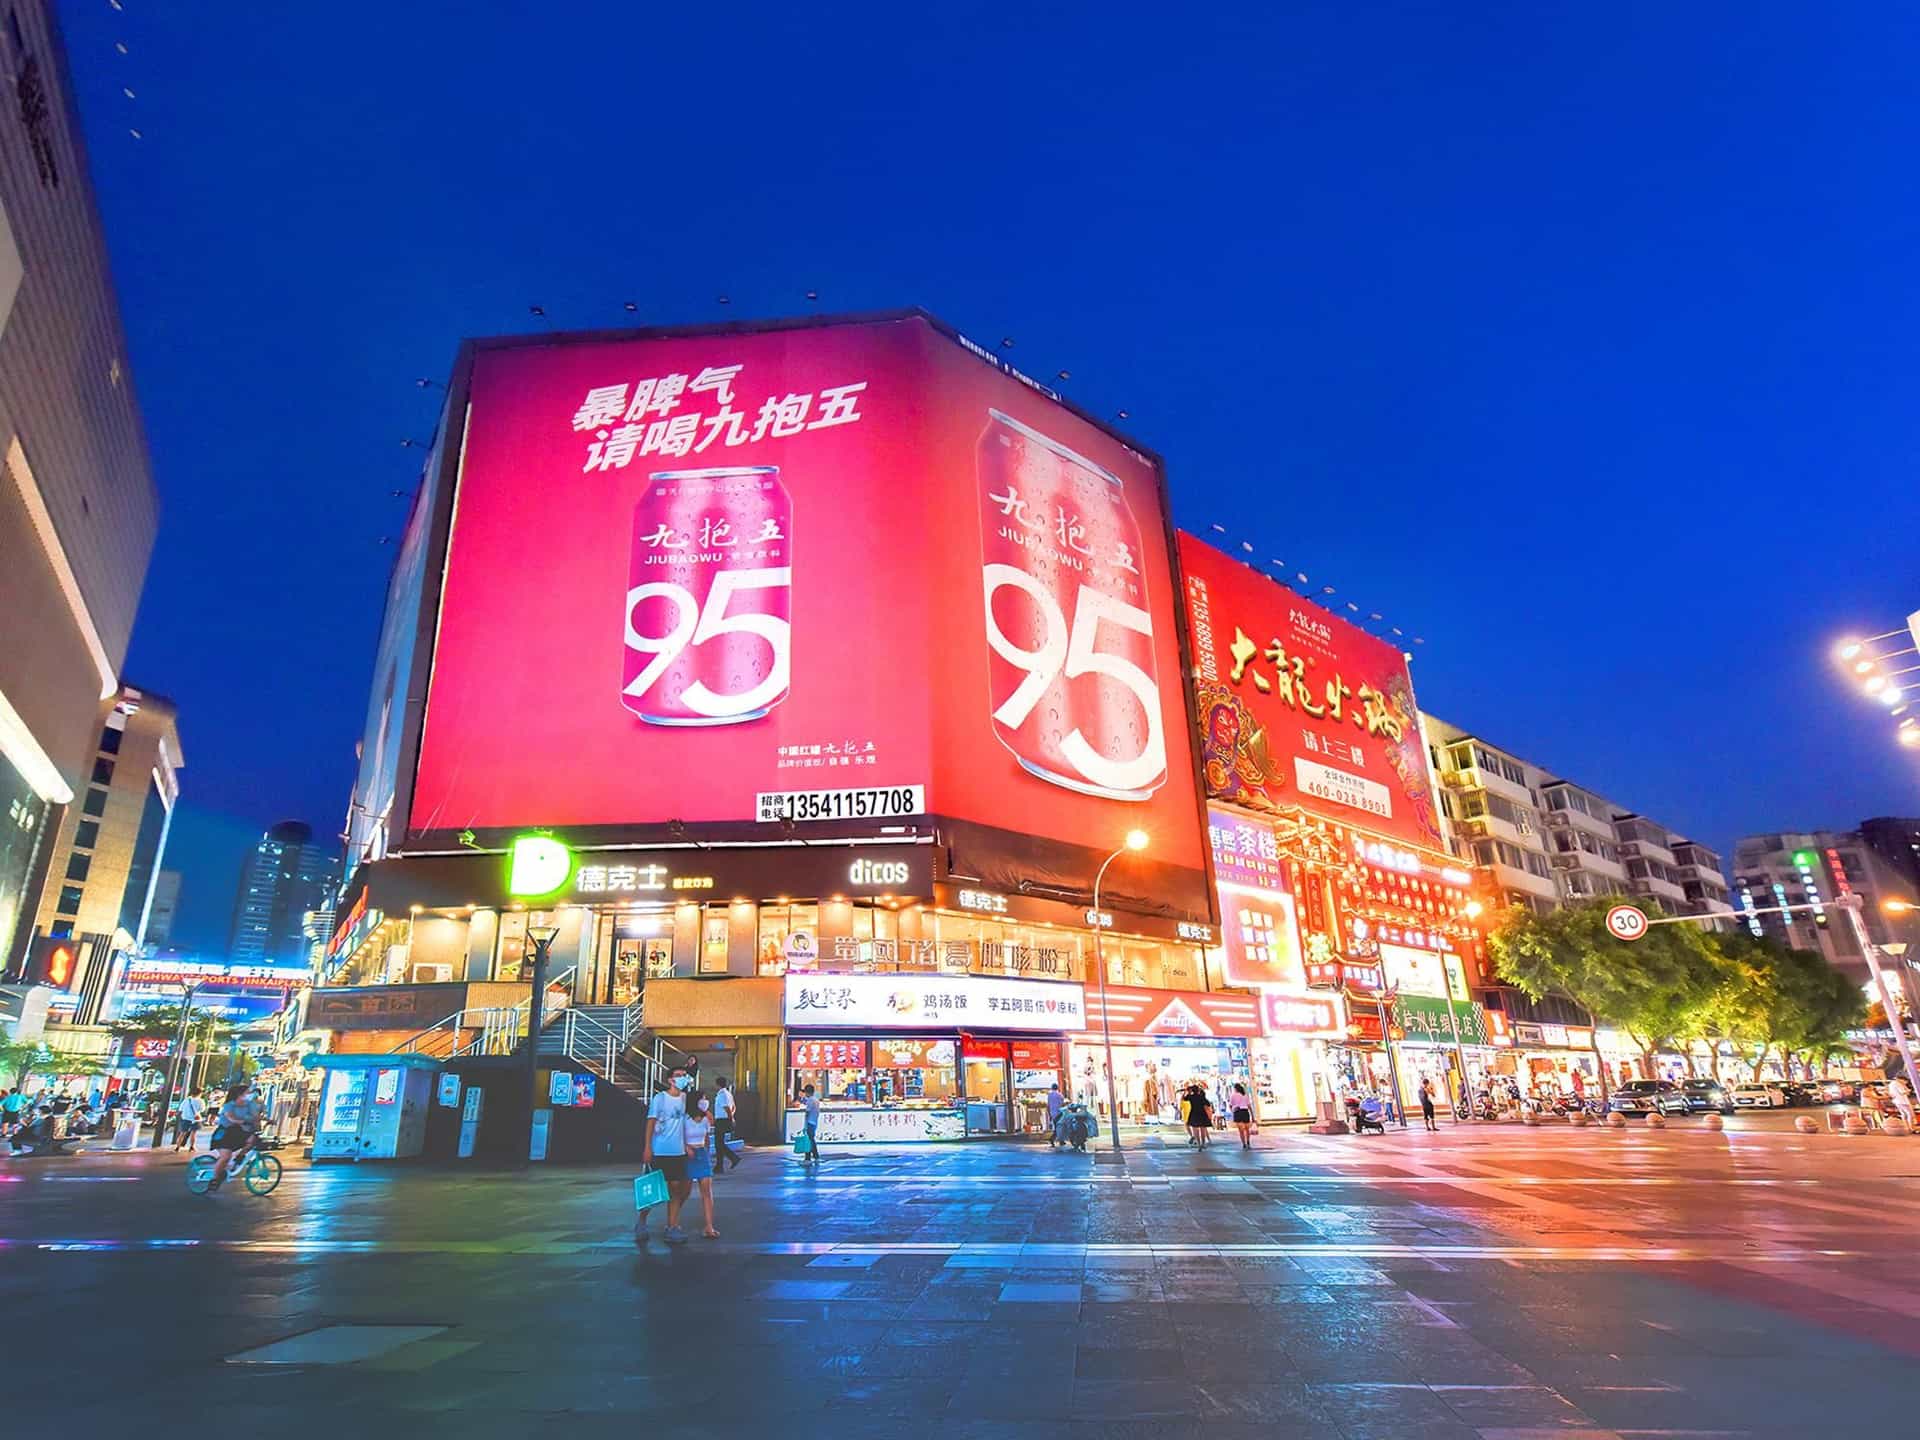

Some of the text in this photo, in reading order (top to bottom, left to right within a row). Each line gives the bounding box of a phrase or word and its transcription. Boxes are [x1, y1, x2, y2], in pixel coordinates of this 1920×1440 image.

[572, 365, 744, 432] 暴脾气
[583, 382, 867, 473] 请喝九抱五
[622, 566, 791, 717] 95
[982, 563, 1166, 790] 95
[761, 795, 784, 806] 招商
[761, 808, 785, 819] 电话
[787, 789, 914, 819] 13541157708
[576, 864, 668, 892] 德克士
[850, 859, 909, 884] dicos
[1615, 914, 1639, 930] 30
